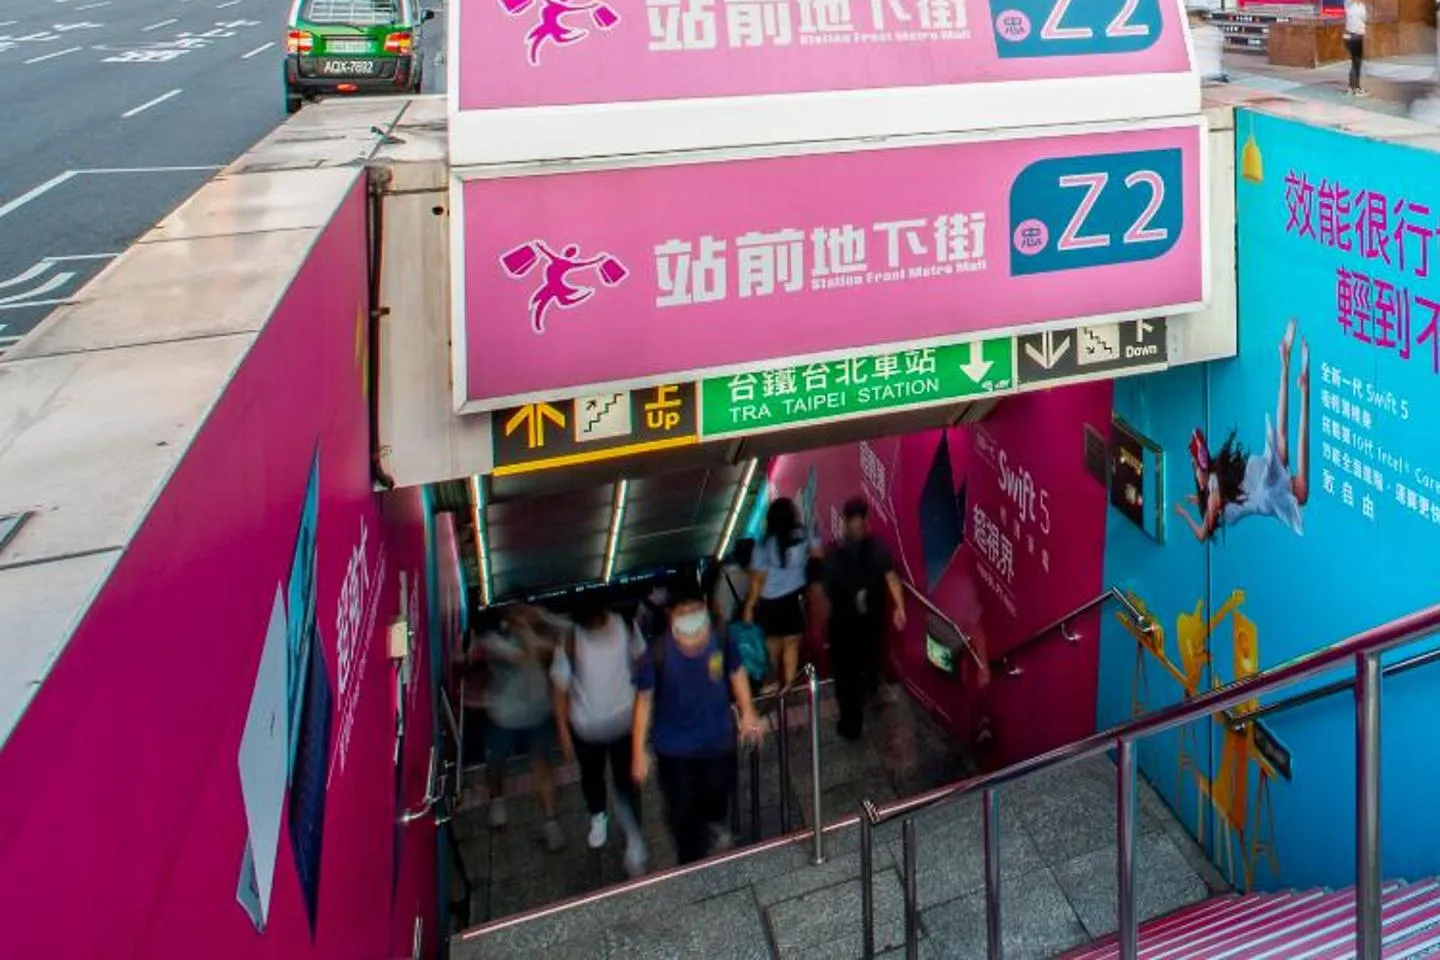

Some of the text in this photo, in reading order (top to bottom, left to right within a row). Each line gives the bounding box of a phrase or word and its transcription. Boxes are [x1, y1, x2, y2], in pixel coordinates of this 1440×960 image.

[800, 28, 971, 45] Station Front Metro Mall
[1057, 170, 1168, 252] Z2
[654, 212, 986, 308] 站前地下街
[811, 260, 987, 290] Station Front Metro Mall
[1125, 344, 1157, 359] Down
[728, 348, 937, 402] 台鐵台北車站
[644, 385, 682, 411] 上
[729, 377, 940, 423] TRA TAIPEI STATION
[1366, 382, 1399, 415] Swift
[1400, 399, 1409, 420] 5
[646, 409, 681, 431] Up
[998, 449, 1051, 535] Swift 5
